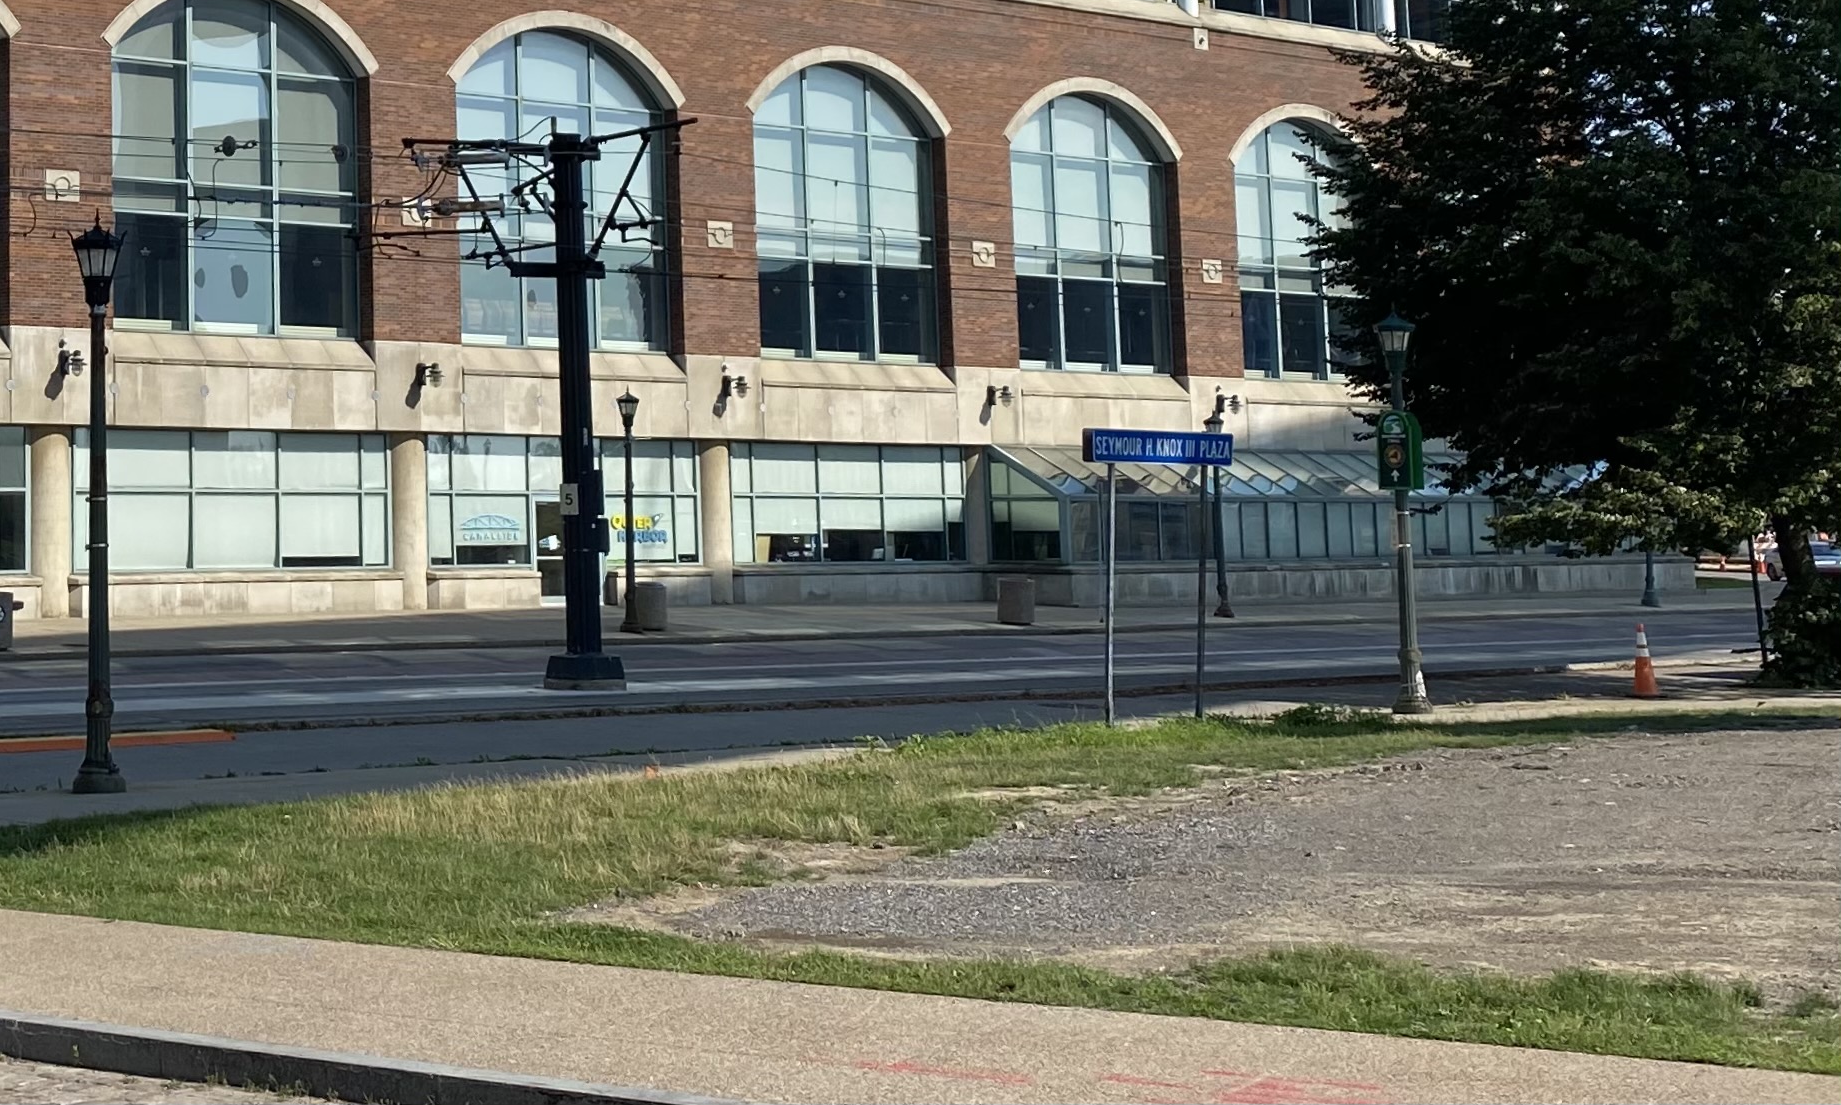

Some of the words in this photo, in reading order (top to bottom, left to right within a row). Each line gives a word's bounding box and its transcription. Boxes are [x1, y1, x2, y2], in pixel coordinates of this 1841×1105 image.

[1096, 435, 1142, 456] SEYMOUR
[1156, 438, 1183, 458] KNOX
[1185, 439, 1196, 458] III
[1199, 440, 1231, 459] PLAZA
[564, 493, 573, 506] 5
[610, 514, 653, 530] OUER
[617, 529, 668, 544] HRBOR
